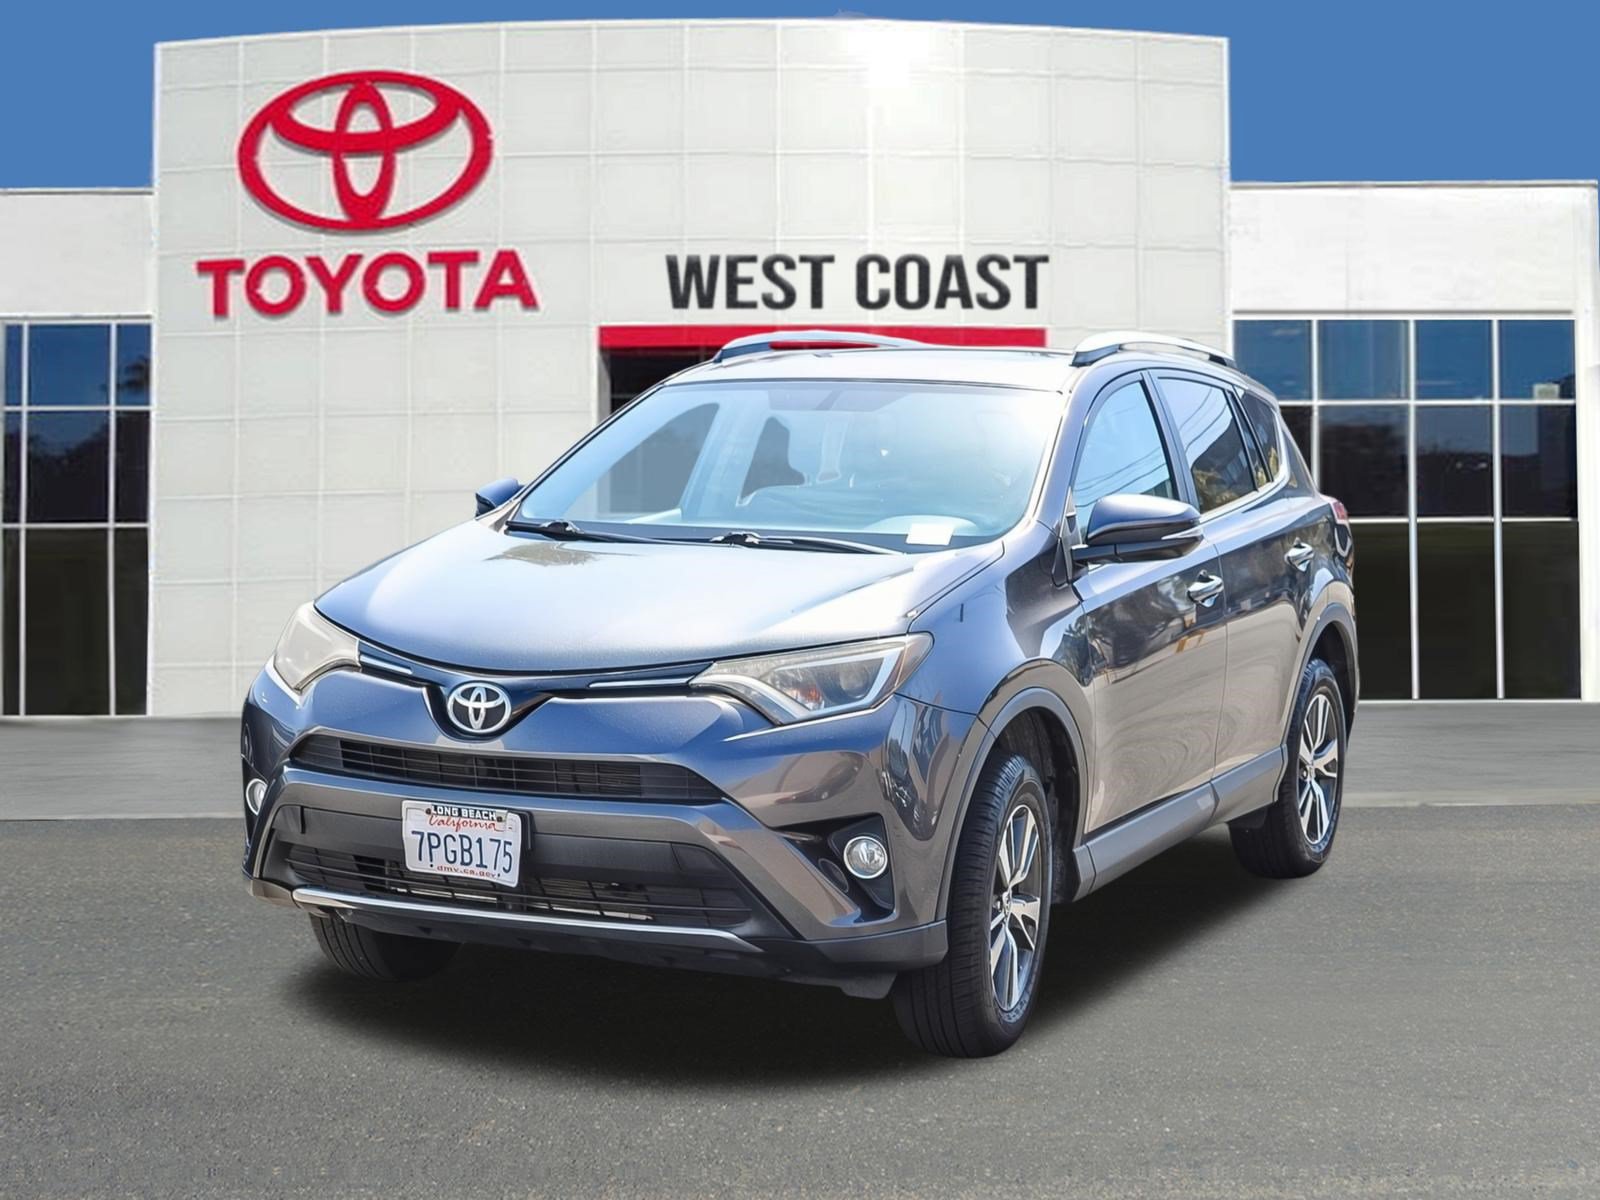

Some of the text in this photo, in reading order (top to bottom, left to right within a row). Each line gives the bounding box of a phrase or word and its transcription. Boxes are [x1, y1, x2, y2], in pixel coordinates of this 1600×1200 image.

[195, 249, 539, 317] TOYOTA
[665, 254, 1049, 311] WEST COAST
[428, 814, 504, 832] California
[431, 805, 497, 820] LONG BEACH
[411, 830, 513, 873] 7PGB175
